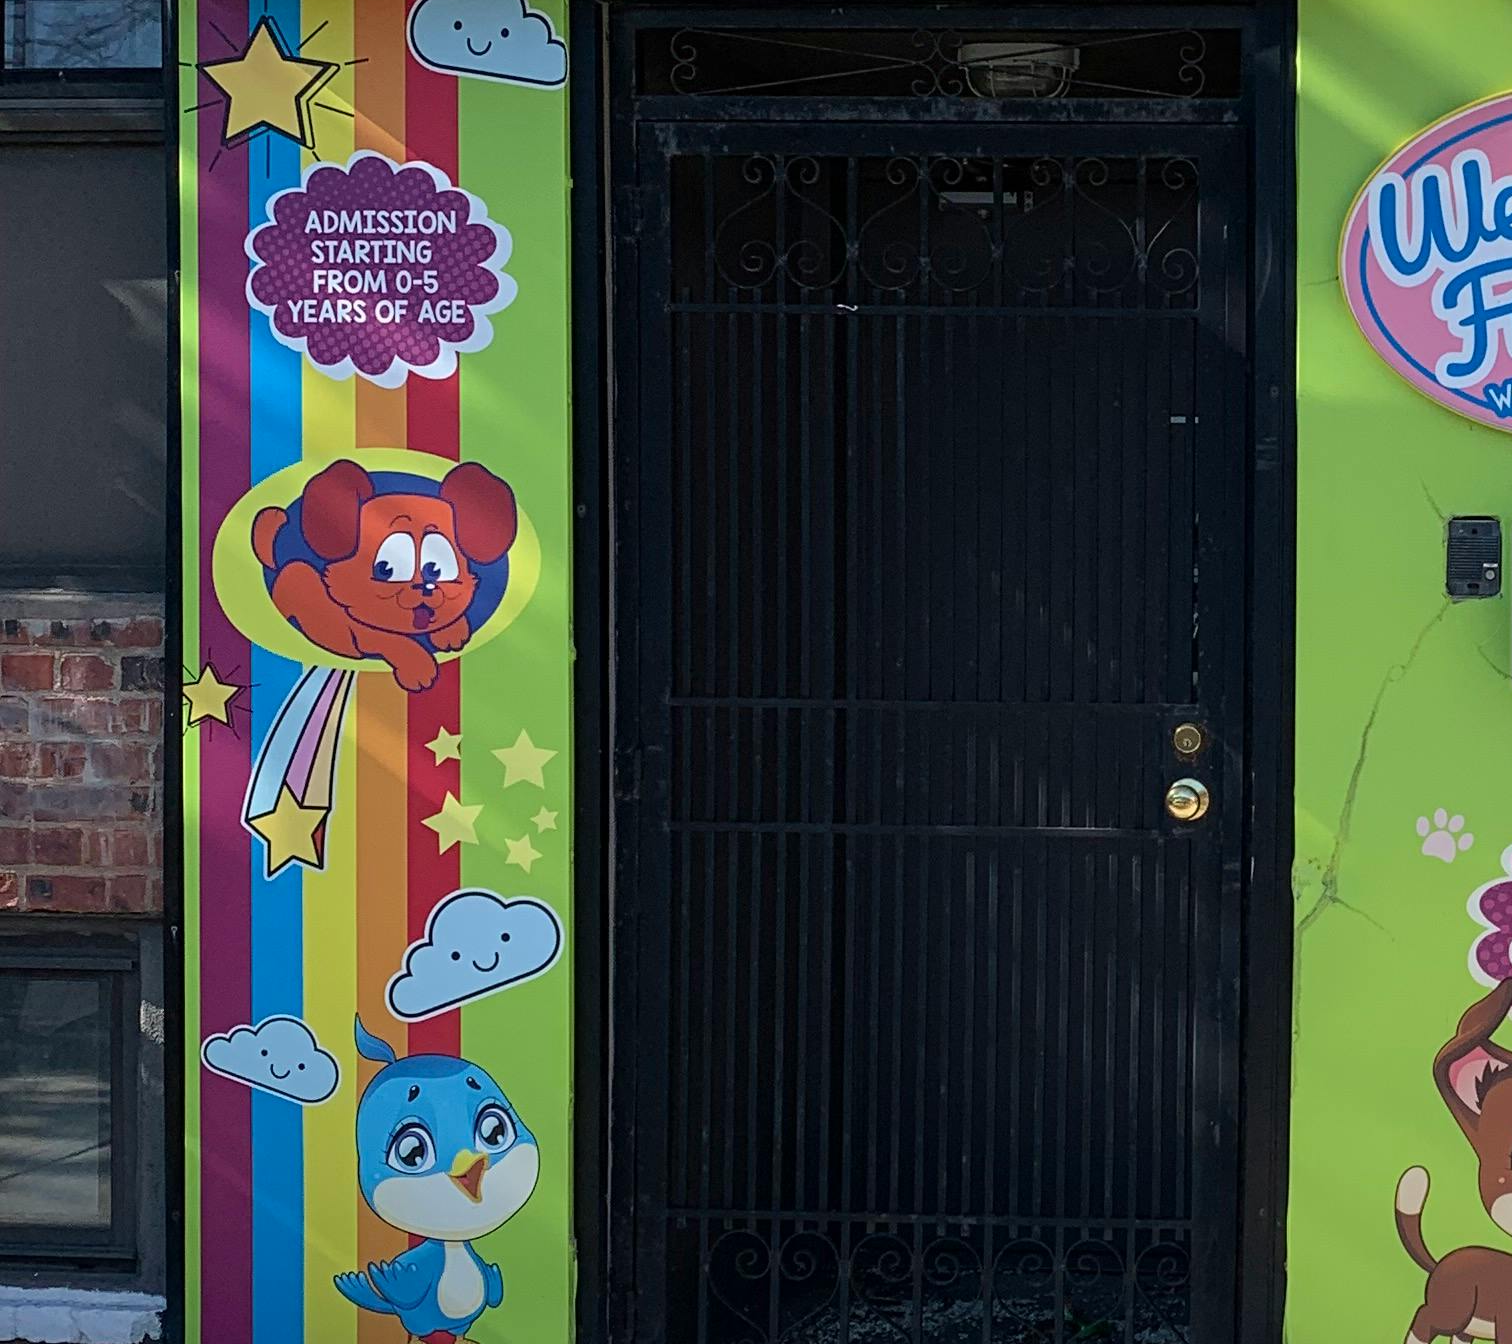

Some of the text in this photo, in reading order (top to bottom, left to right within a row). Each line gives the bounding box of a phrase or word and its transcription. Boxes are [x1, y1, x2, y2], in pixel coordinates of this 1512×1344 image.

[304, 210, 457, 234] ADMISSION
[311, 240, 432, 264] STARTING
[312, 270, 439, 294] FROM 0-5
[287, 300, 466, 324] YEARS OF AGE
